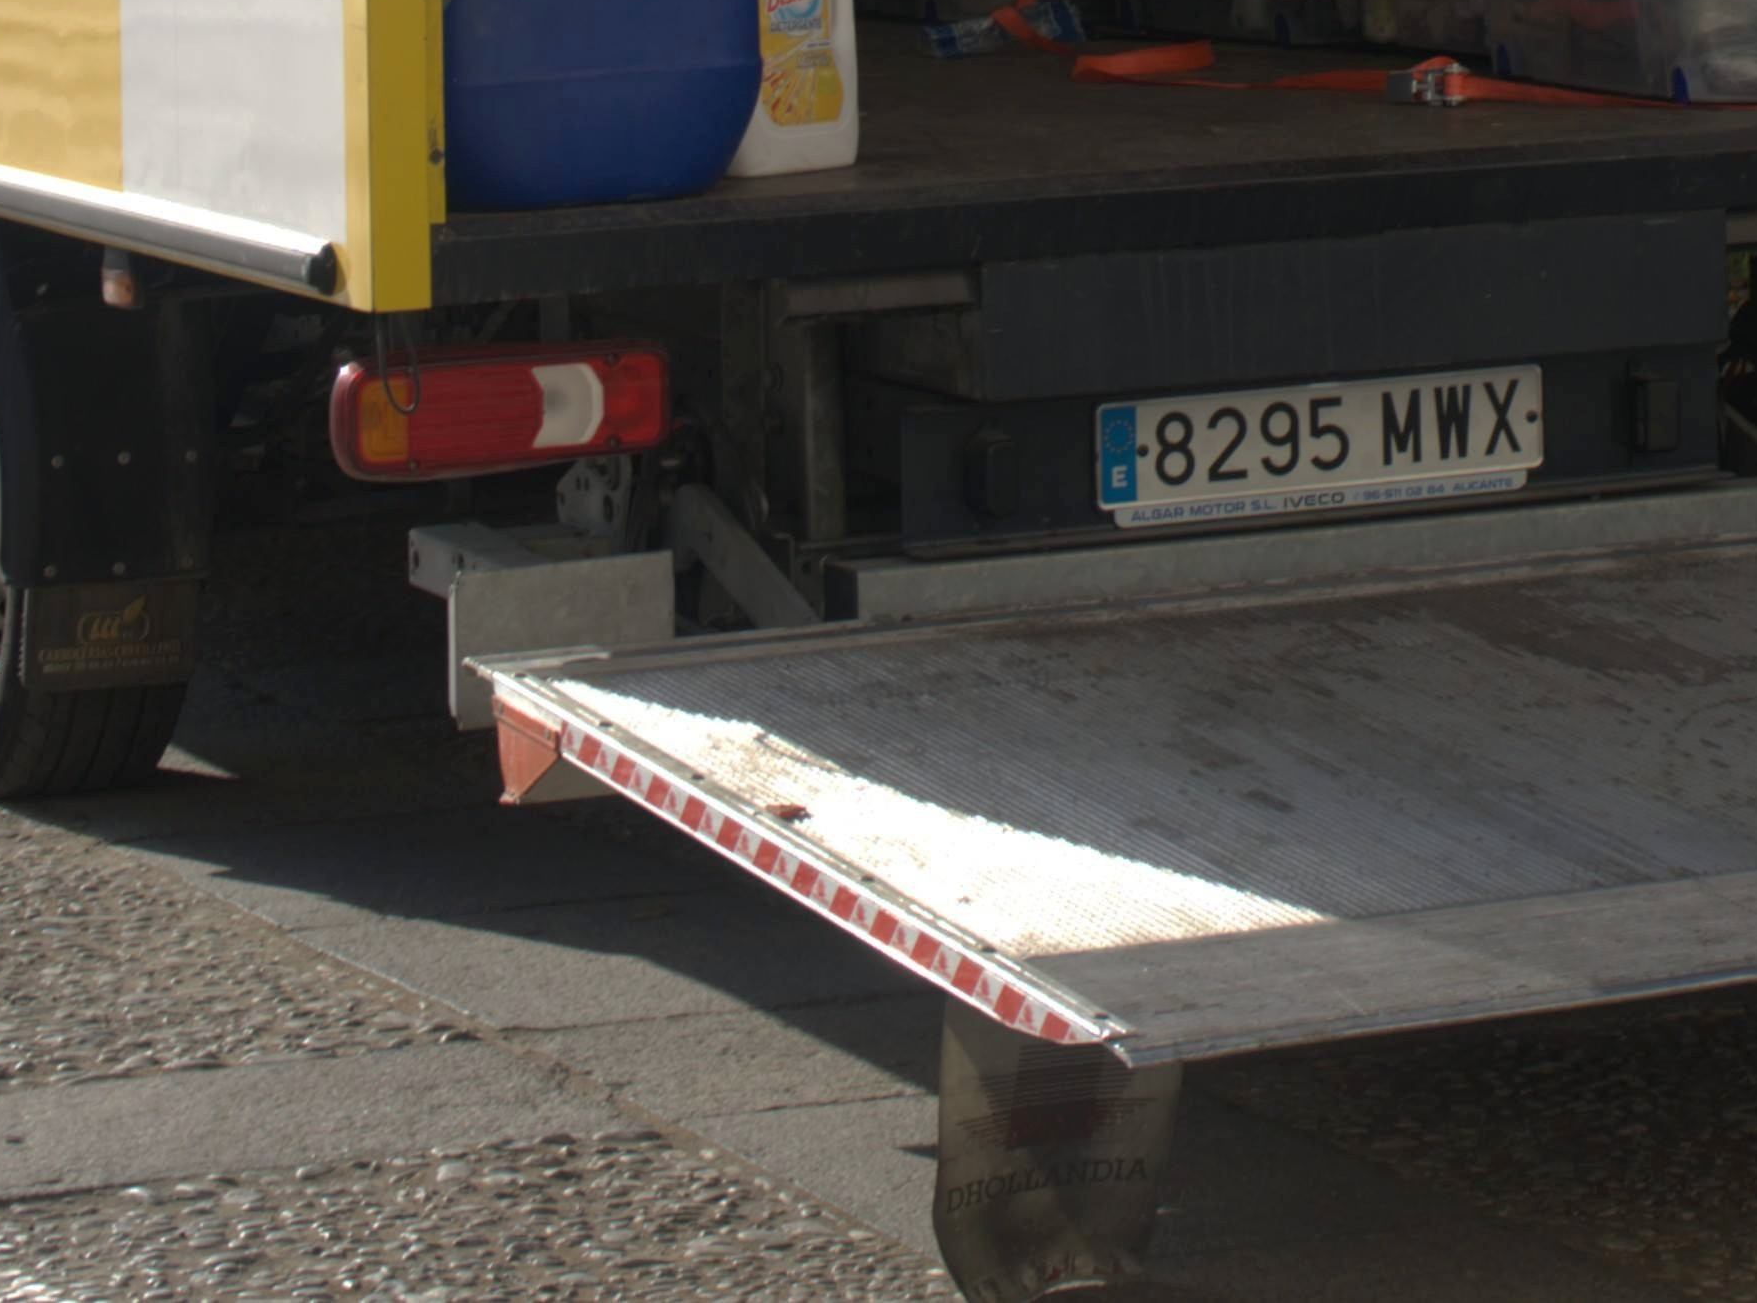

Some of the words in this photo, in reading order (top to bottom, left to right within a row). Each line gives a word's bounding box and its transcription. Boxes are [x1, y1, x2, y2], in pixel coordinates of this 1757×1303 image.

[1154, 396, 1350, 488] 8295
[1382, 379, 1522, 467] MWX
[1110, 465, 1128, 489] E
[1131, 506, 1184, 523] ALGAR
[1189, 499, 1245, 517] MOTOR
[1283, 491, 1345, 509] IVECO
[1451, 477, 1514, 493] ALICANTE
[946, 1157, 1149, 1214] DHOLLANDIA
